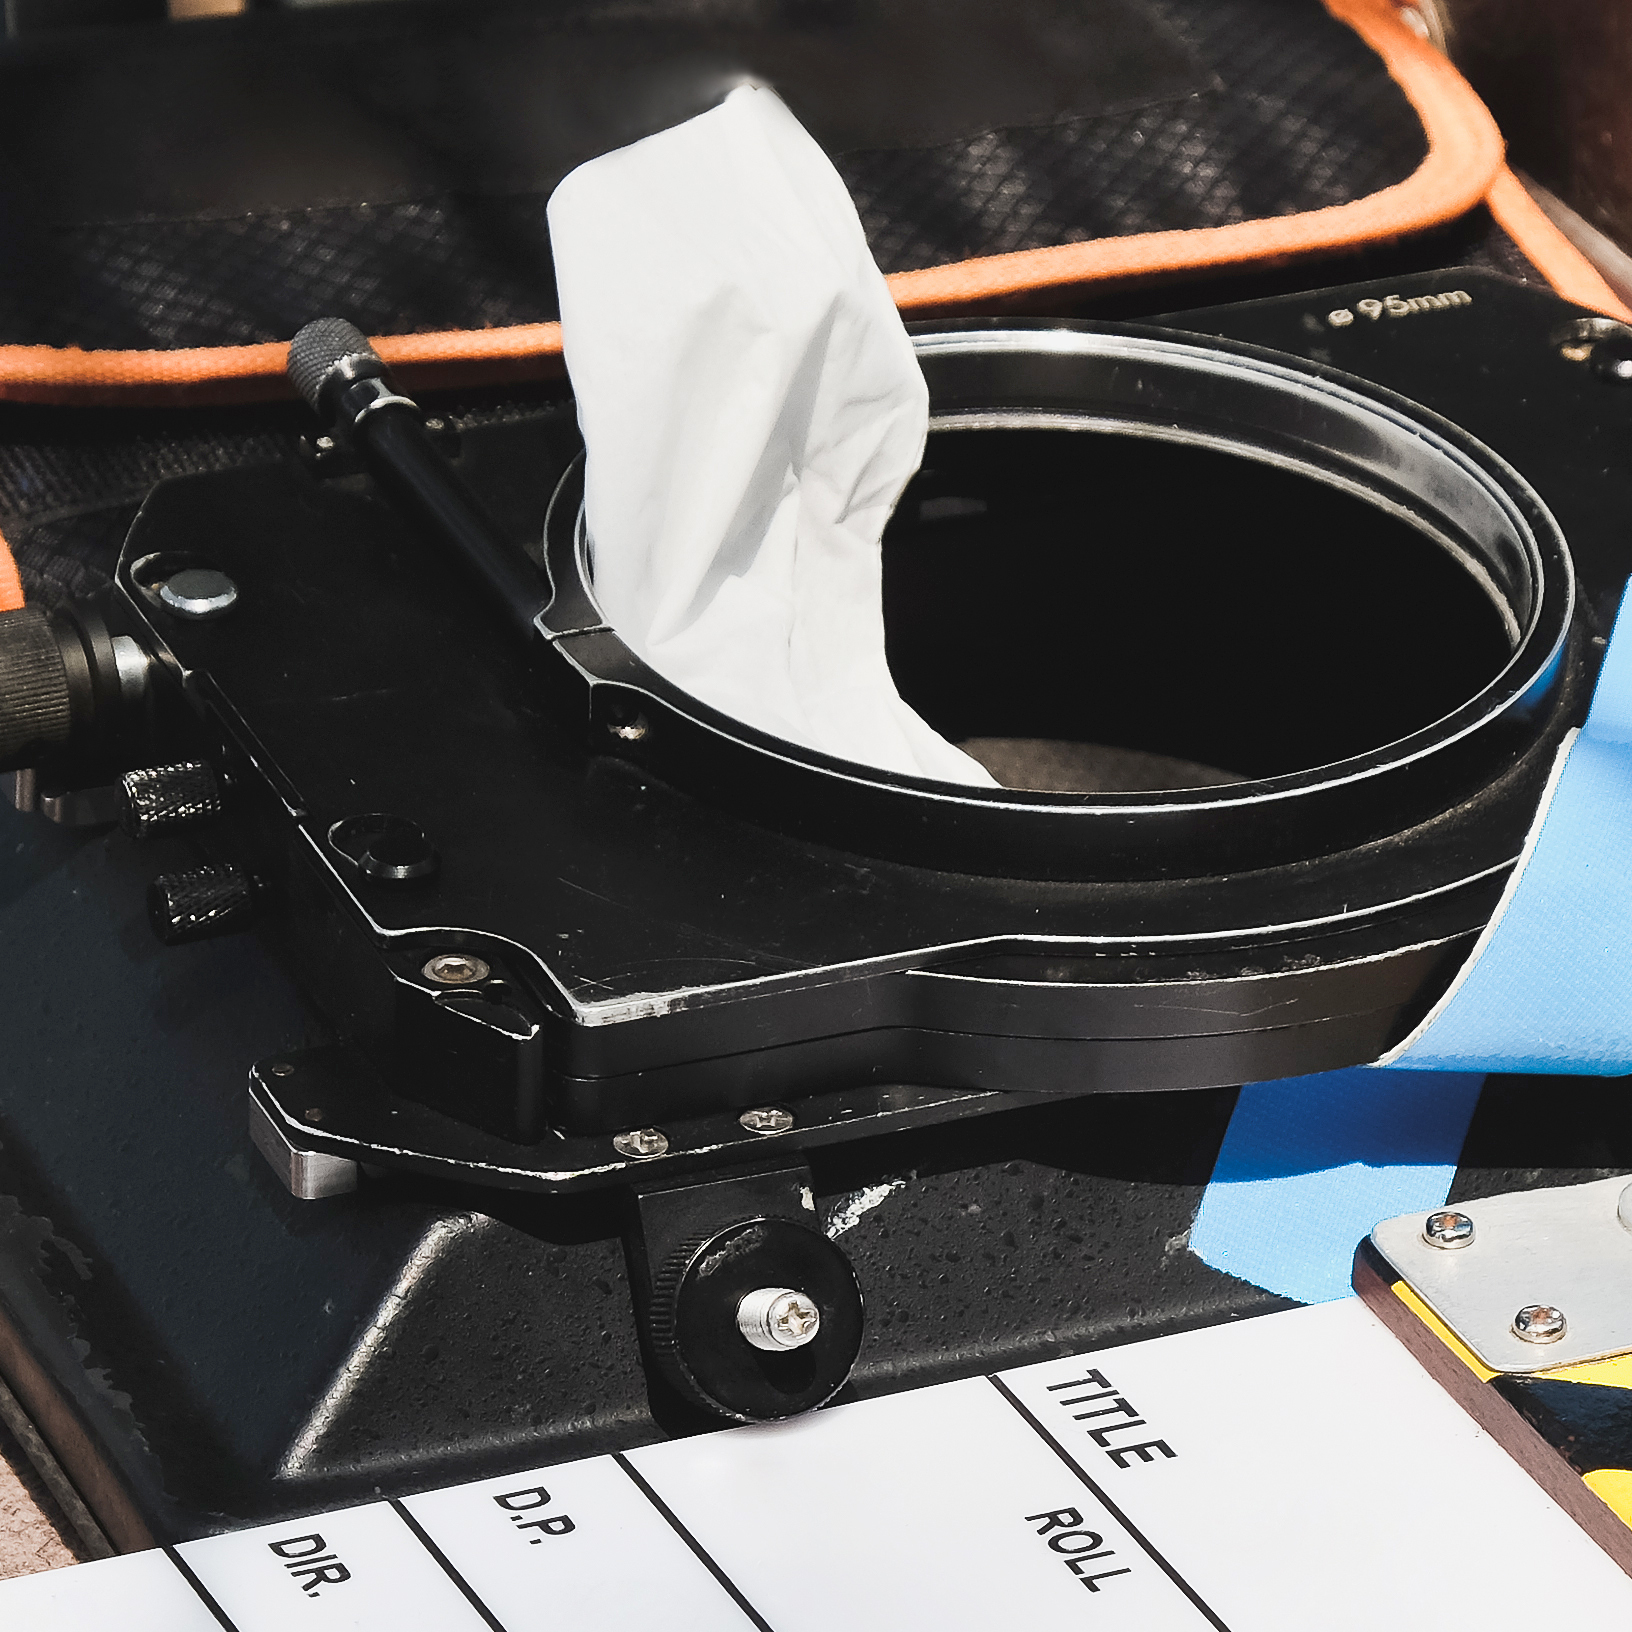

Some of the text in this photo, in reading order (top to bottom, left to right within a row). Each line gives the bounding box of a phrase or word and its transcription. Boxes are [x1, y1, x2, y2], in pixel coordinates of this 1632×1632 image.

[1045, 1367, 1179, 1471] TITLE
[491, 1485, 577, 1546] D.P.
[1023, 1506, 1133, 1594] ROLL
[266, 1532, 353, 1599] DIR.
